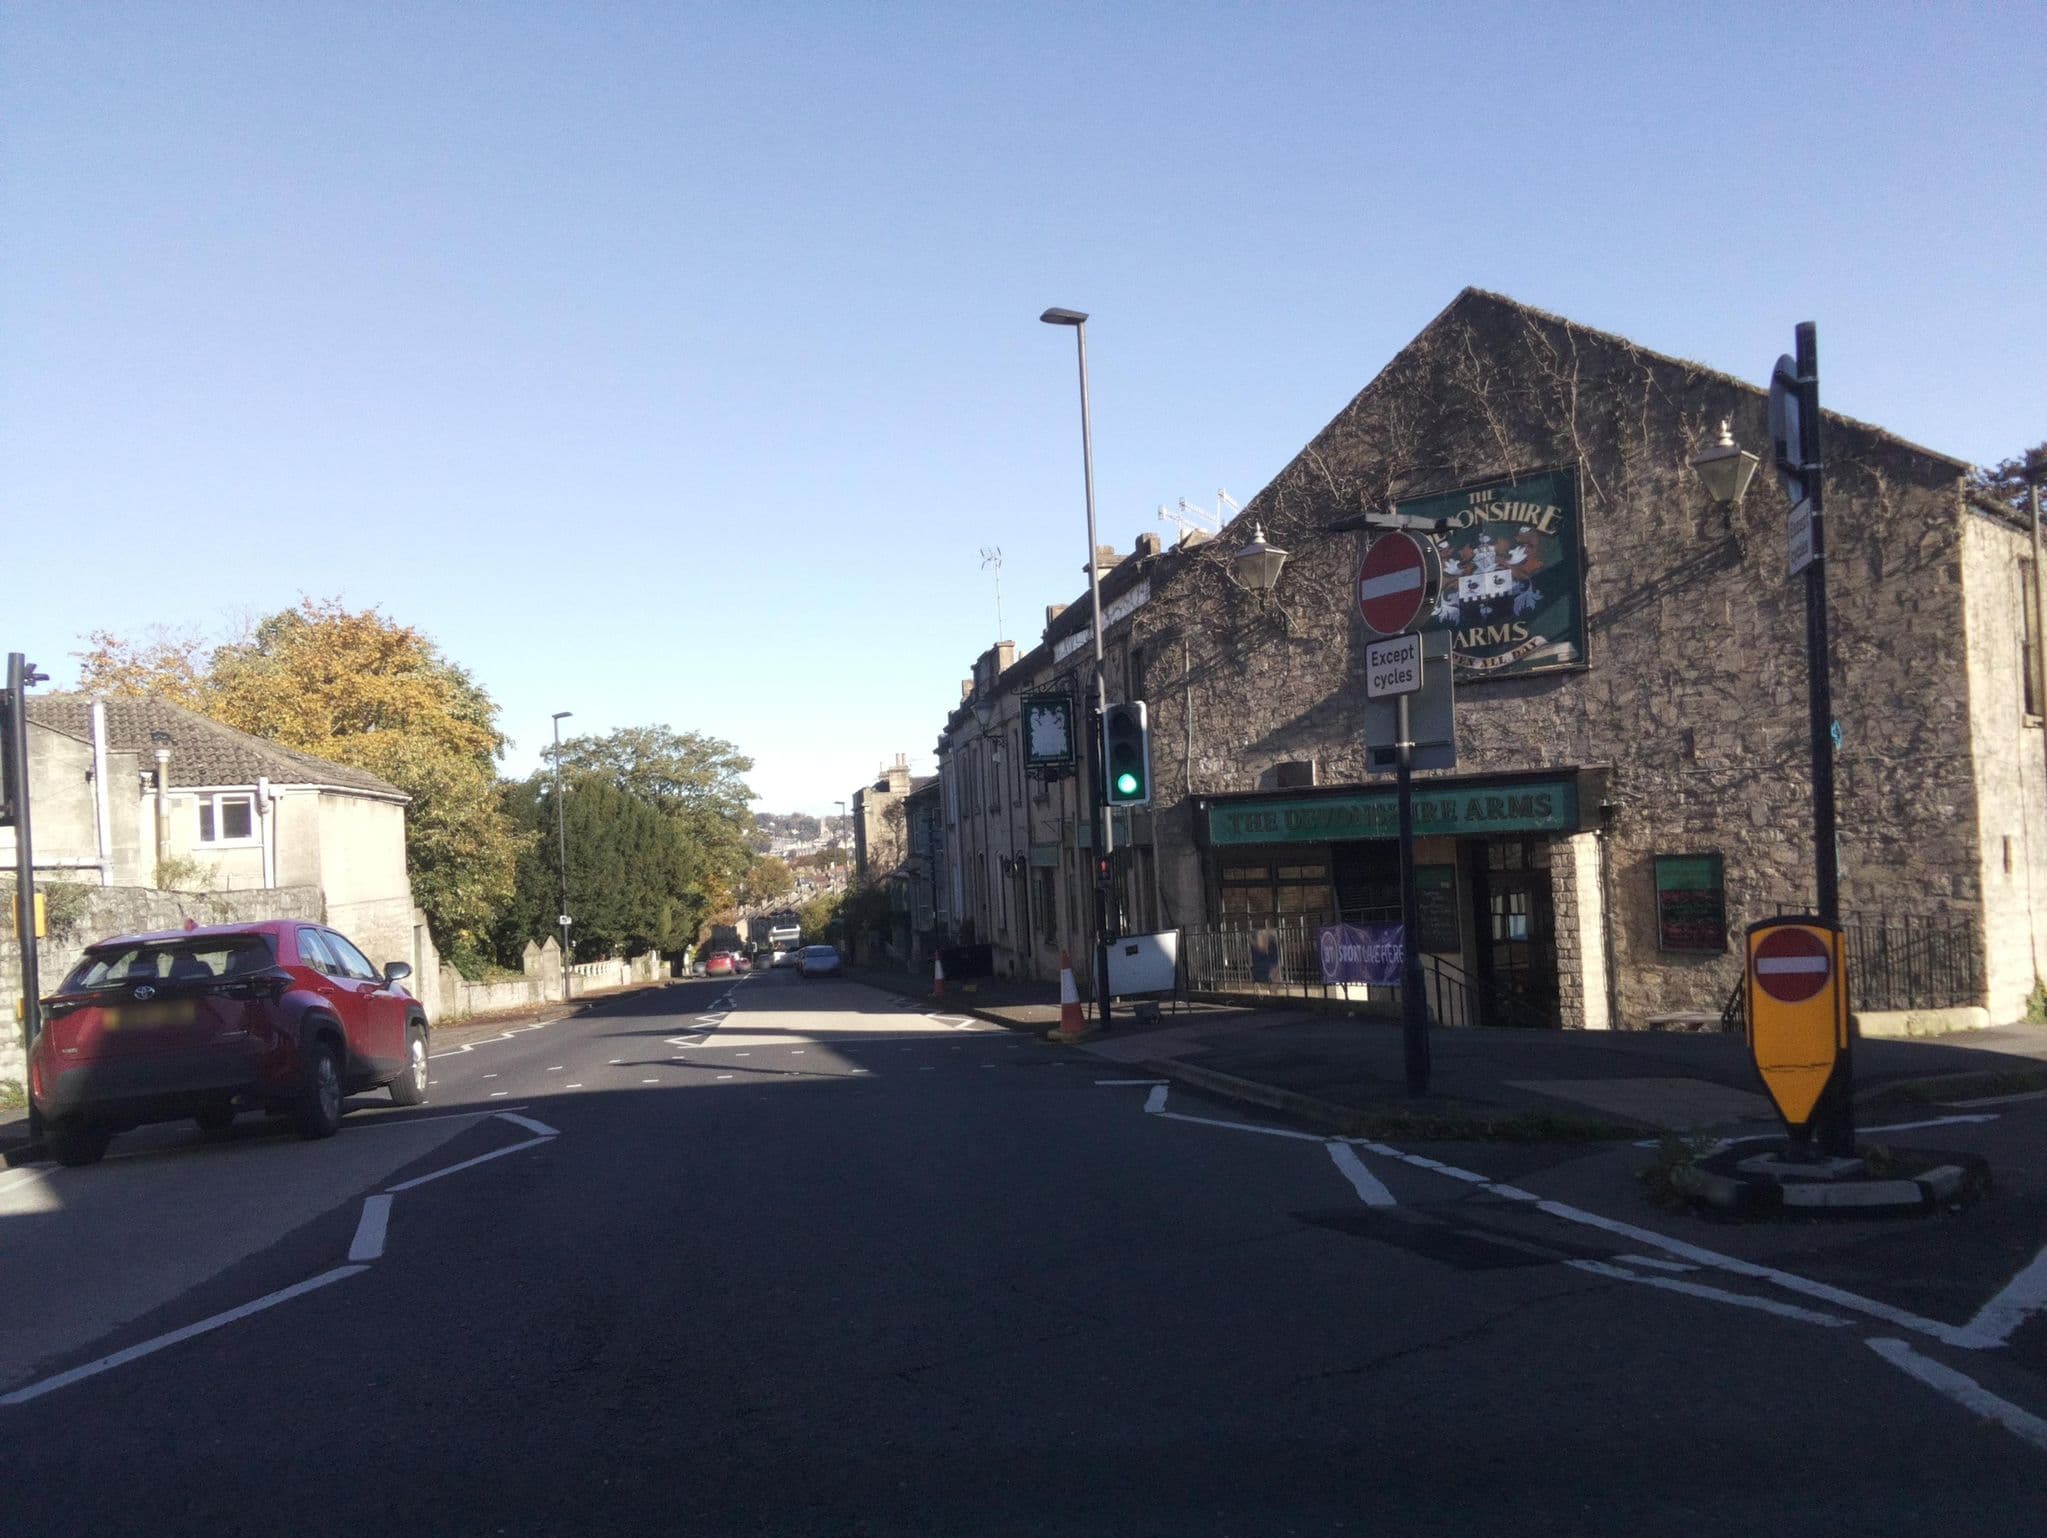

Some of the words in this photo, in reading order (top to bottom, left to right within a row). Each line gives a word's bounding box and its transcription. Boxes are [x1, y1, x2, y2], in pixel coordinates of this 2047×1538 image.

[1467, 489, 1497, 504] THE
[1432, 501, 1562, 544] ONSHIRE
[1453, 621, 1528, 648] ARMS
[1371, 644, 1415, 667] Except
[1374, 668, 1413, 690] cycles
[1228, 810, 1279, 833] THE
[1464, 794, 1552, 821] ARMS
